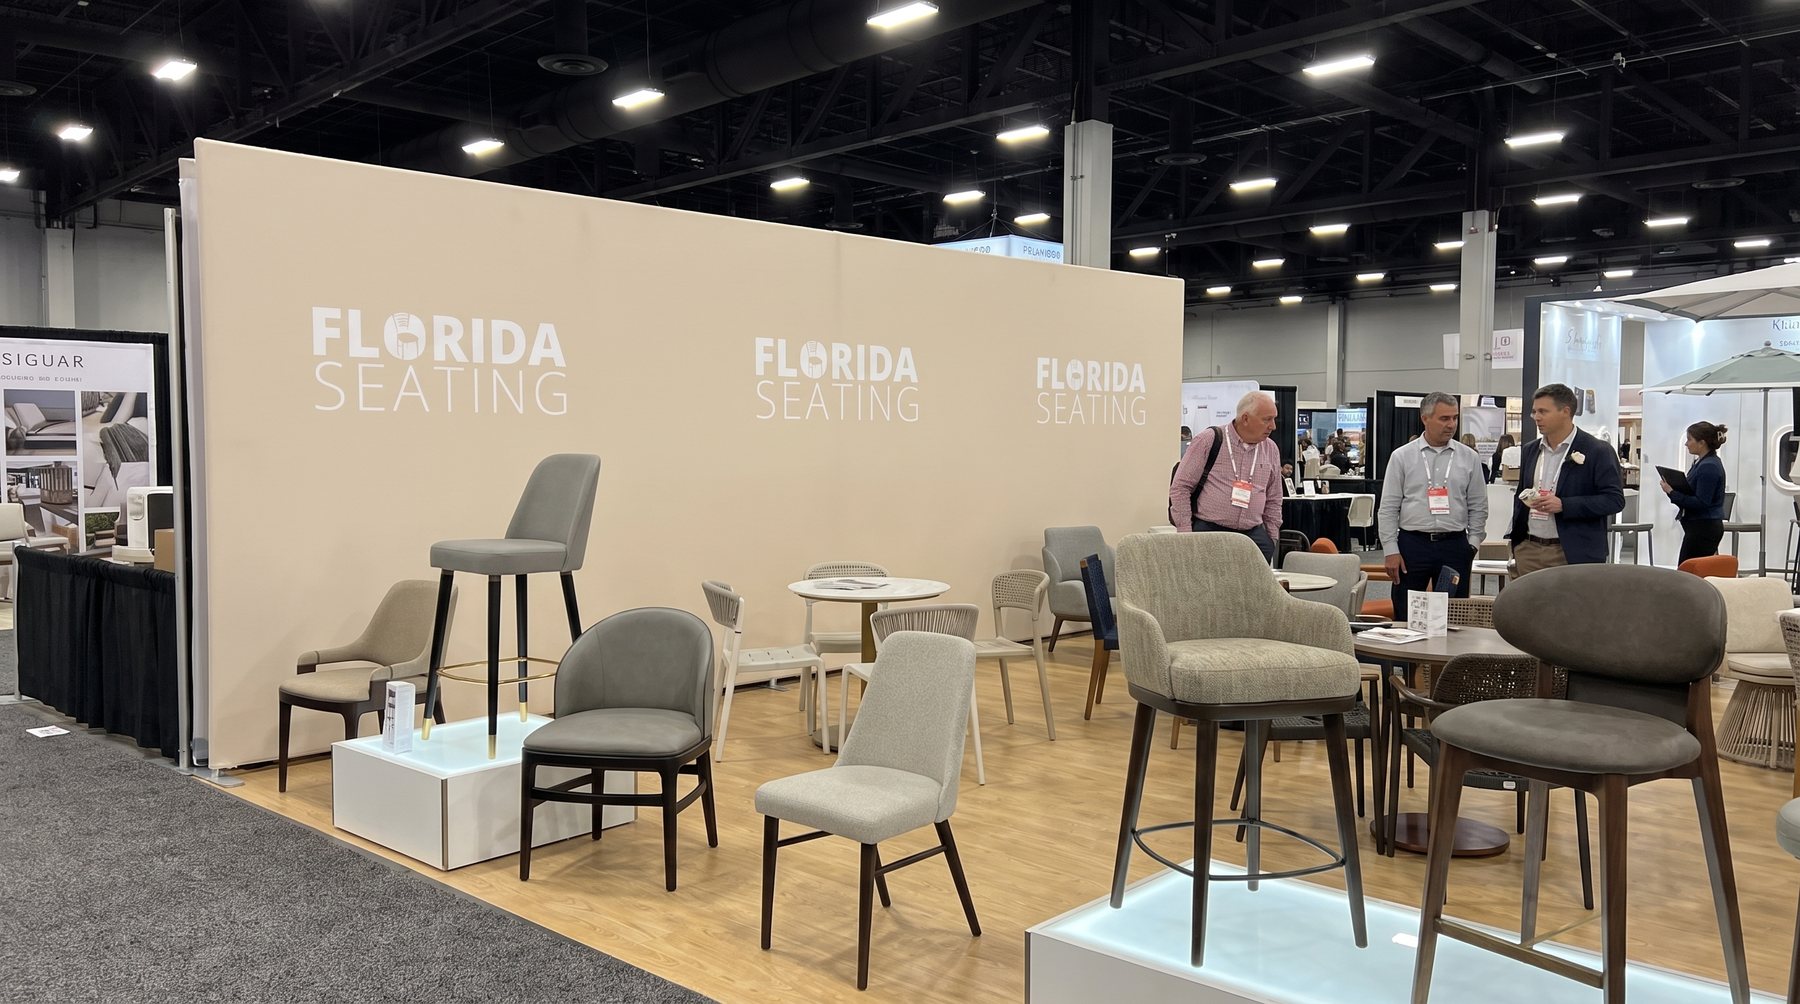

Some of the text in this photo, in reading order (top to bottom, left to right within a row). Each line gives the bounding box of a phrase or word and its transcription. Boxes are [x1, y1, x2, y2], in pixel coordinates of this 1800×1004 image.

[312, 306, 567, 368] FLORIDA
[755, 337, 919, 383] FLORIDA
[1036, 357, 1146, 393] FLORIDA
[314, 360, 568, 416] SEATING
[756, 380, 919, 422] SEATING
[1036, 391, 1146, 426] SEATING
